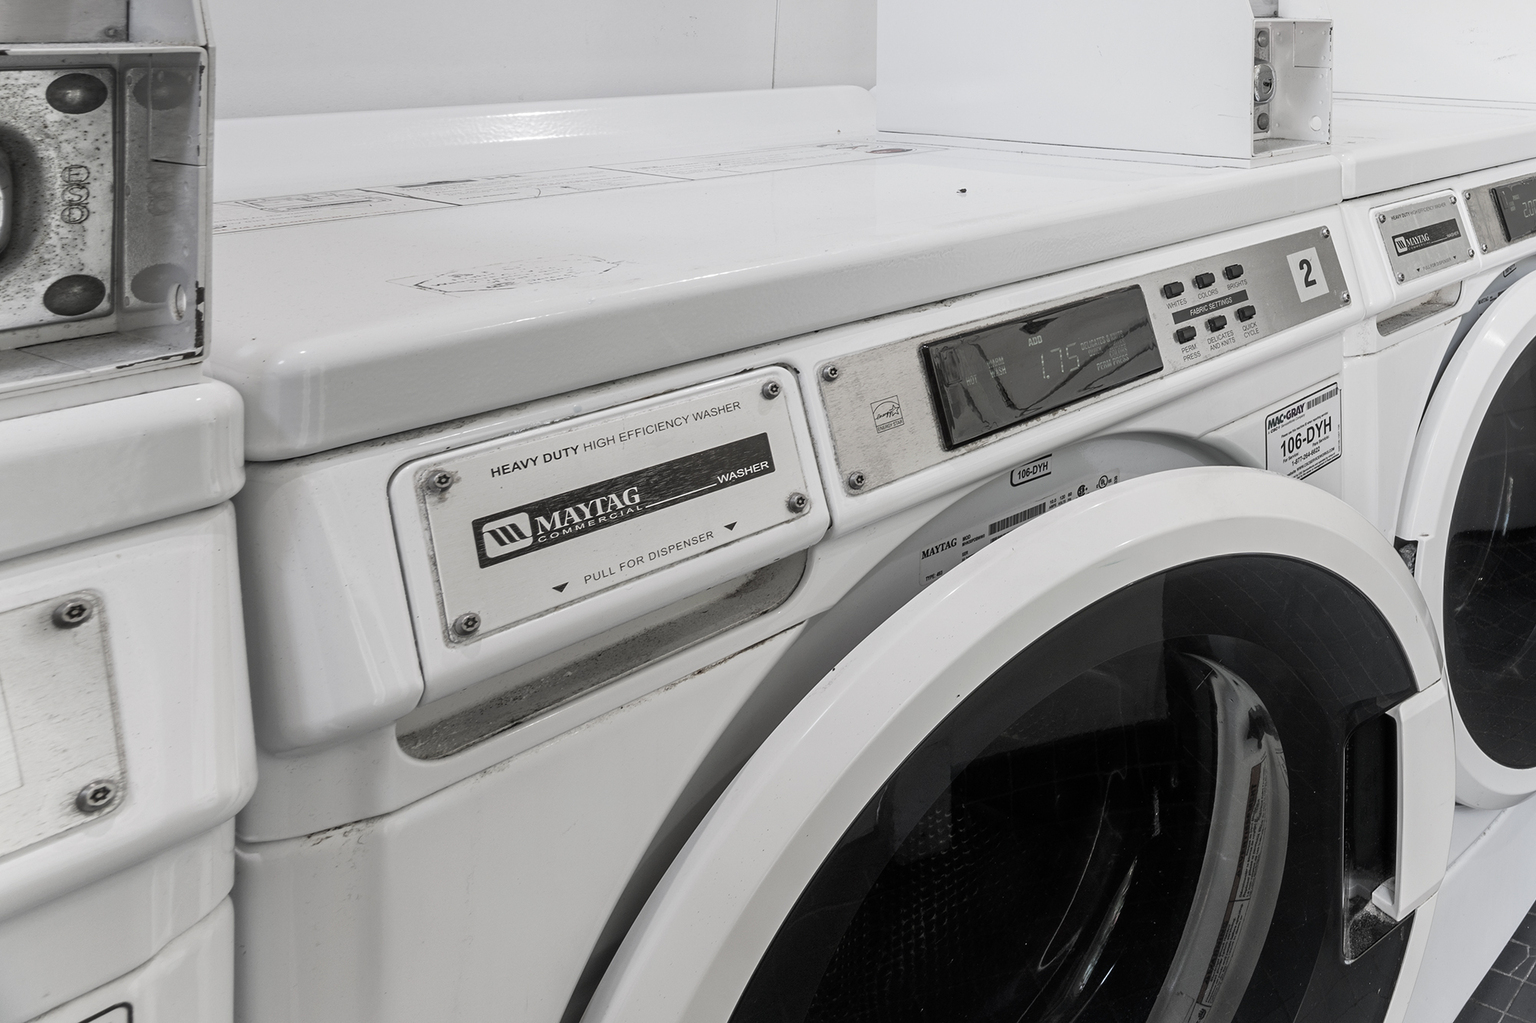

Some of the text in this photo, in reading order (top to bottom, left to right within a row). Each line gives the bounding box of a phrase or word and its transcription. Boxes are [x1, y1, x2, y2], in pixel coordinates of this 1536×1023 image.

[1406, 232, 1429, 246] MAYTAG
[1299, 258, 1317, 288] 2
[1226, 278, 1247, 290] BRIGHTS
[1197, 287, 1218, 299] COLORS
[1166, 297, 1187, 309] WHITES
[1189, 296, 1232, 315] FABRIC SETTINGS
[1242, 321, 1257, 331] QUICK
[1243, 327, 1259, 338] CYCLE
[1028, 335, 1042, 346] ADD
[1206, 329, 1234, 344] DELICATES
[1210, 336, 1235, 350] AND KNITS
[1181, 343, 1196, 352] PERM
[1182, 350, 1201, 361] PRESS
[490, 400, 742, 478] HEAVY DUTY HIGH EFFICIENCY WASHER
[1280, 416, 1331, 457] 106-DYH
[716, 460, 770, 484] WASHER
[1016, 461, 1048, 480] 106-DYH
[535, 485, 642, 533] MAYTAG
[536, 505, 644, 542] COMMERCIAL
[921, 537, 956, 559] MAYTAG
[583, 530, 714, 584] PULL FOR DISPENSER
